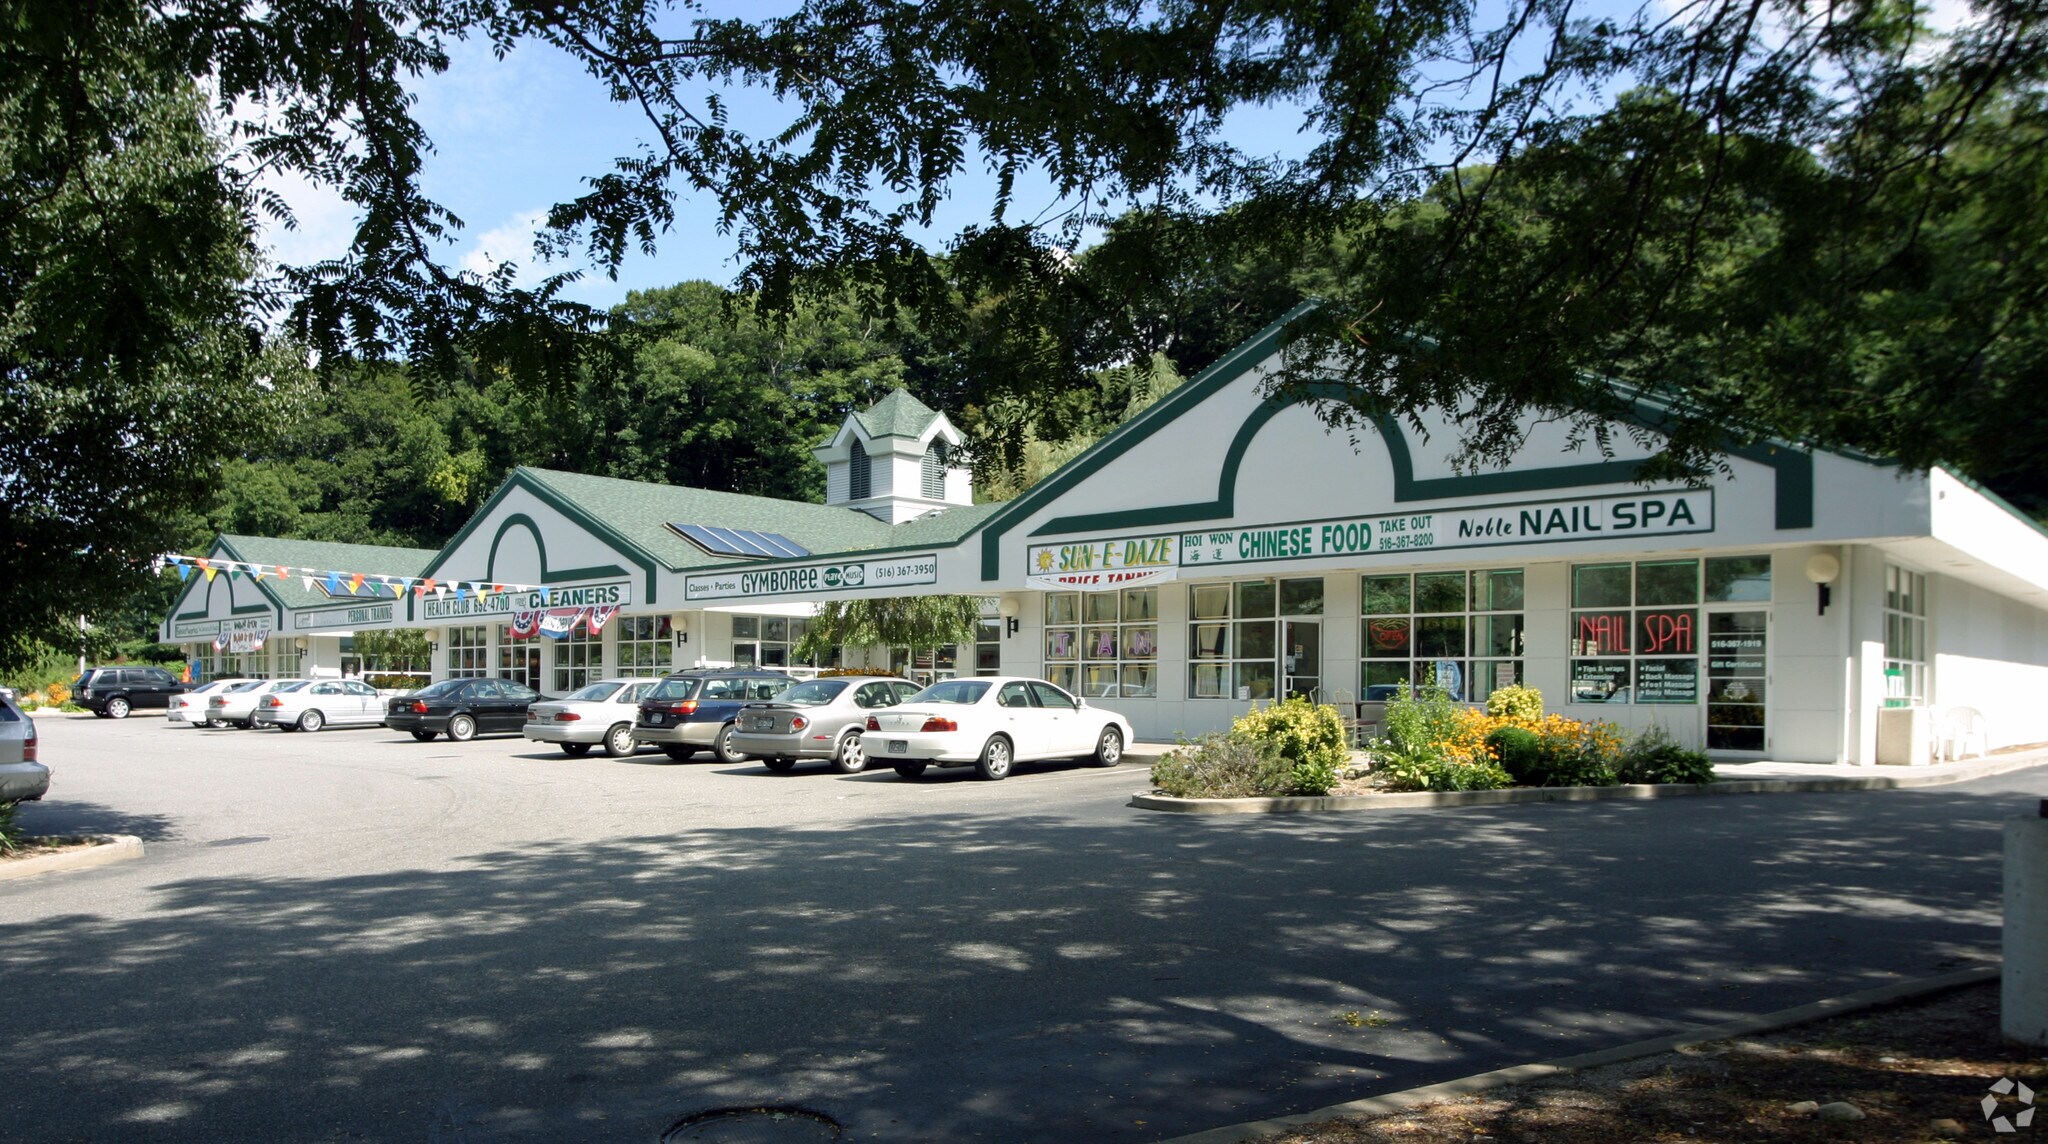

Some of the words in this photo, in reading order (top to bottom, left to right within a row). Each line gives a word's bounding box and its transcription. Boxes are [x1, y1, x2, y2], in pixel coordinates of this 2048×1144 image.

[1379, 519, 1406, 533] TAKE
[1411, 515, 1432, 530] OUT
[1458, 517, 1512, 539] Noble
[1519, 505, 1601, 536] NAIL
[1612, 498, 1695, 530] SPA
[1184, 535, 1202, 548] HOI
[1209, 532, 1233, 546] WON
[1238, 526, 1312, 559] CHINESE
[1321, 522, 1372, 553] FOOD
[1379, 532, 1434, 550] 516-367-8200
[1058, 537, 1173, 572] SUN-E-DAZE
[845, 570, 863, 580] MUSIC
[875, 566, 895, 580] (516)
[897, 563, 935, 577] 367-3950
[689, 584, 709, 593] Classes
[715, 580, 736, 591] Parties
[529, 585, 620, 609] CLEANERS
[348, 606, 370, 623] PERSONAL
[371, 605, 392, 621] TRAINING
[427, 600, 451, 616] HEALTH
[453, 599, 470, 615] CLUB
[1579, 614, 1630, 653] NAIL
[1644, 613, 1692, 653] SPA
